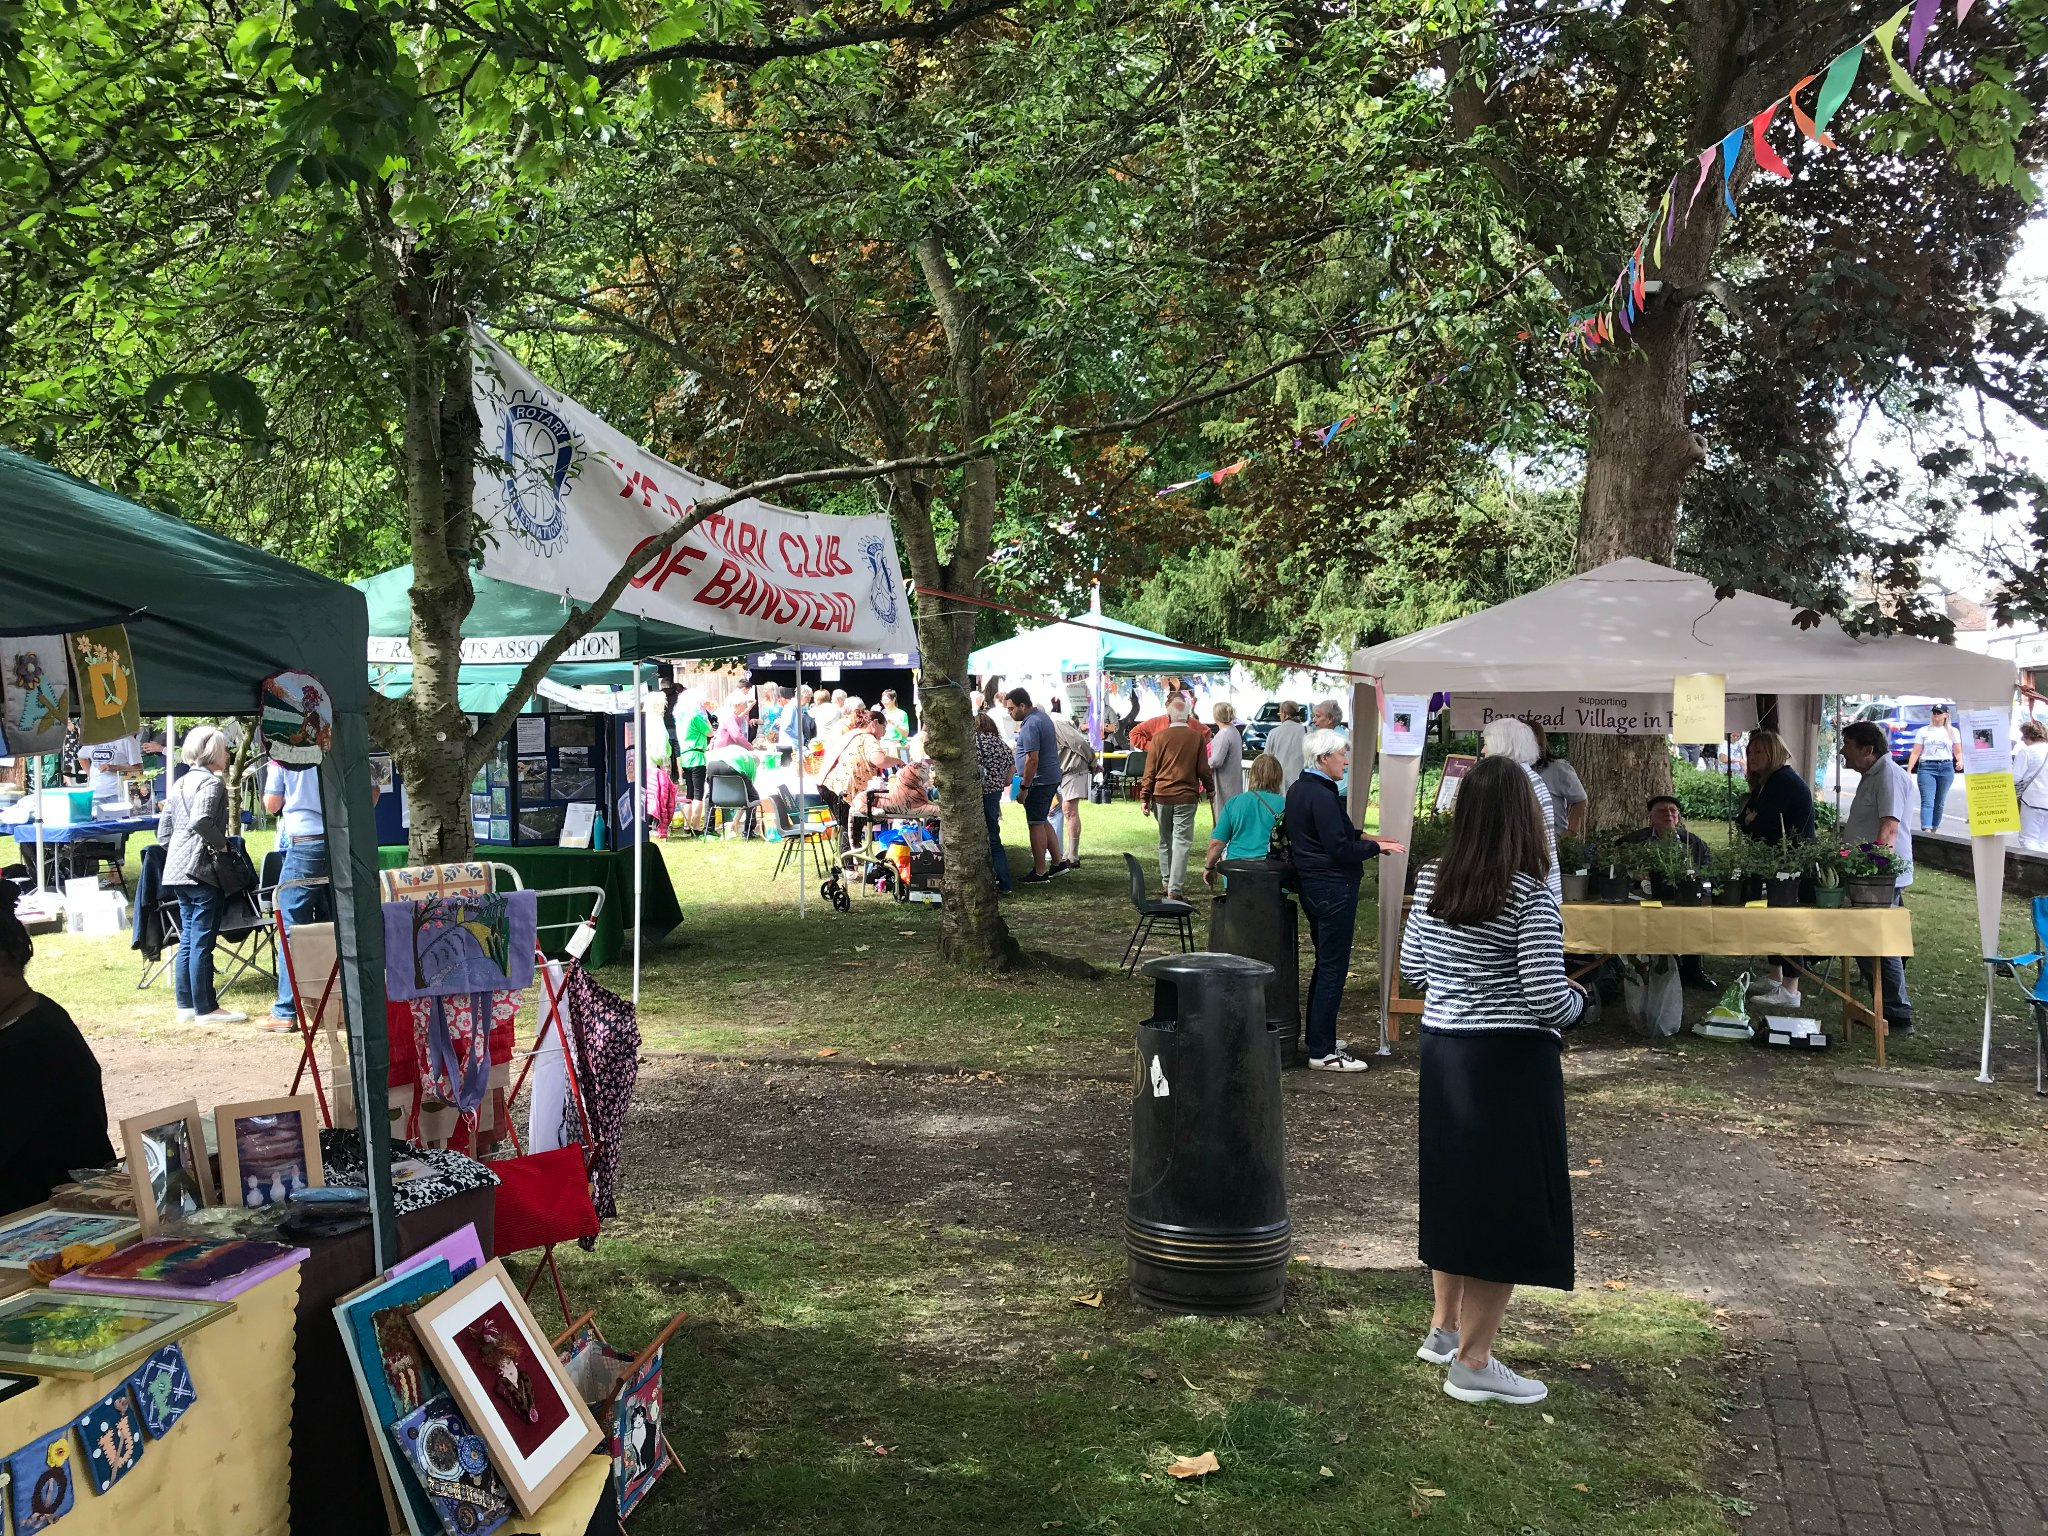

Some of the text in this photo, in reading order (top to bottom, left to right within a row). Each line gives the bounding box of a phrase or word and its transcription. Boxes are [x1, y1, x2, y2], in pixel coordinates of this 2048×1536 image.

[516, 406, 568, 437] ROTARY
[778, 531, 853, 578] CLUB
[625, 534, 856, 633] OF BANSTEAD
[492, 636, 613, 658] ASSOTION
[803, 652, 844, 661] DIAMOND
[1578, 696, 1627, 708] supporting
[1576, 708, 1638, 733] Village
[1643, 712, 1662, 729] in
[1976, 809, 2008, 817] SATURDAY
